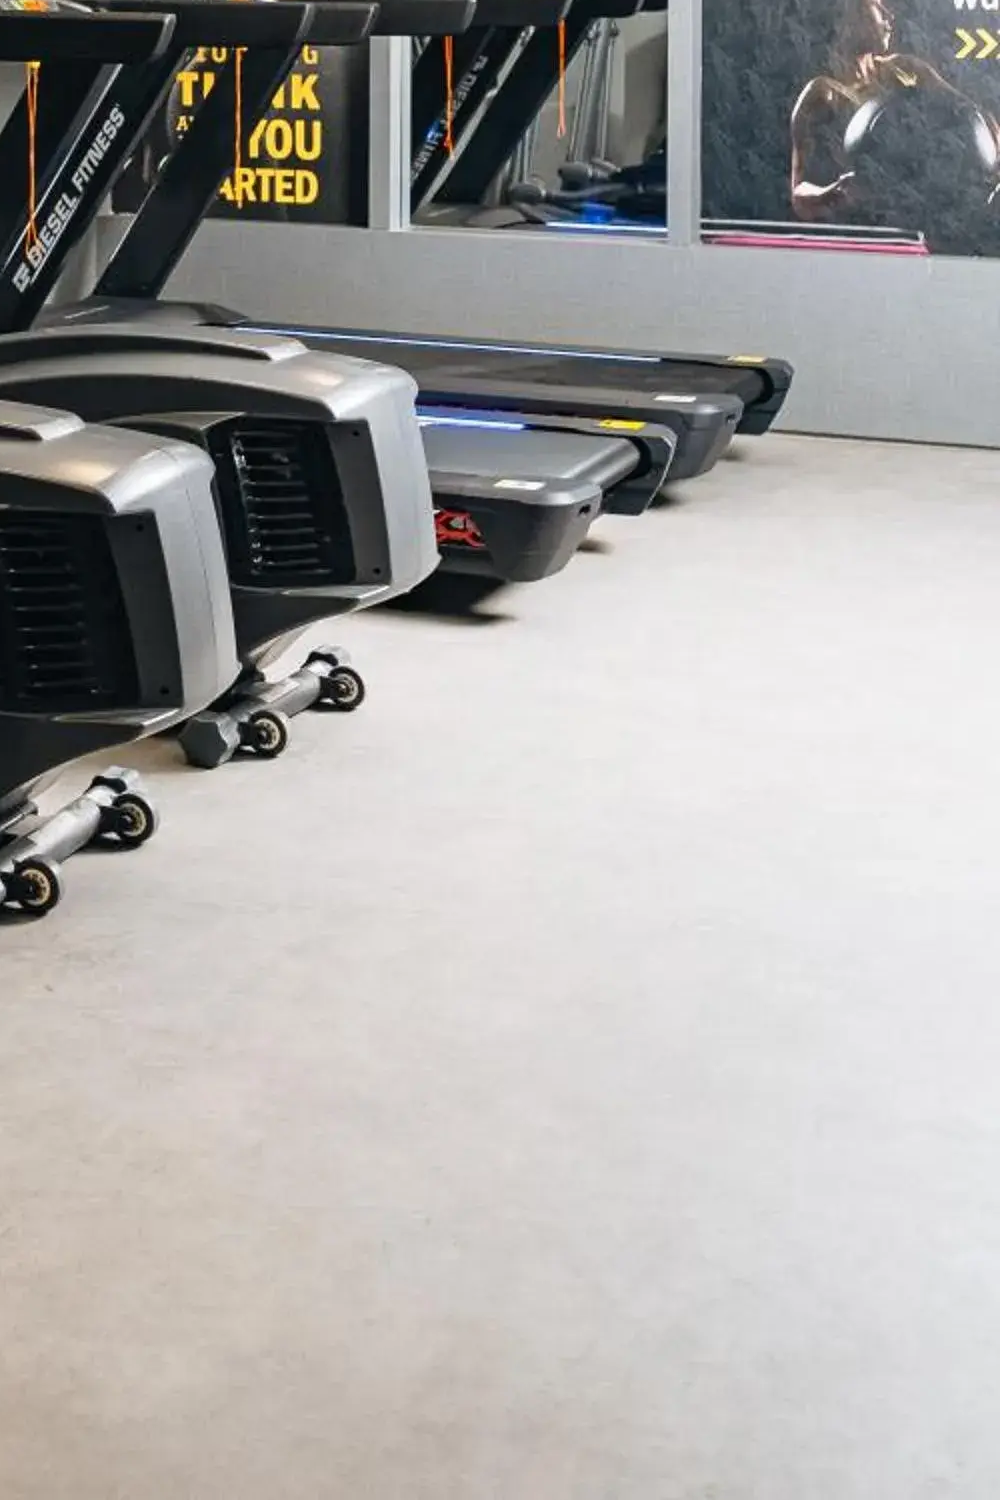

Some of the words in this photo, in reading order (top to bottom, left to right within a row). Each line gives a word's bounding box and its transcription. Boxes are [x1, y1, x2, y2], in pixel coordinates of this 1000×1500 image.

[249, 119, 321, 160] YOU
[27, 192, 78, 267] DIESEL
[71, 106, 126, 192] FITNESS
[218, 167, 319, 204] ARTED
